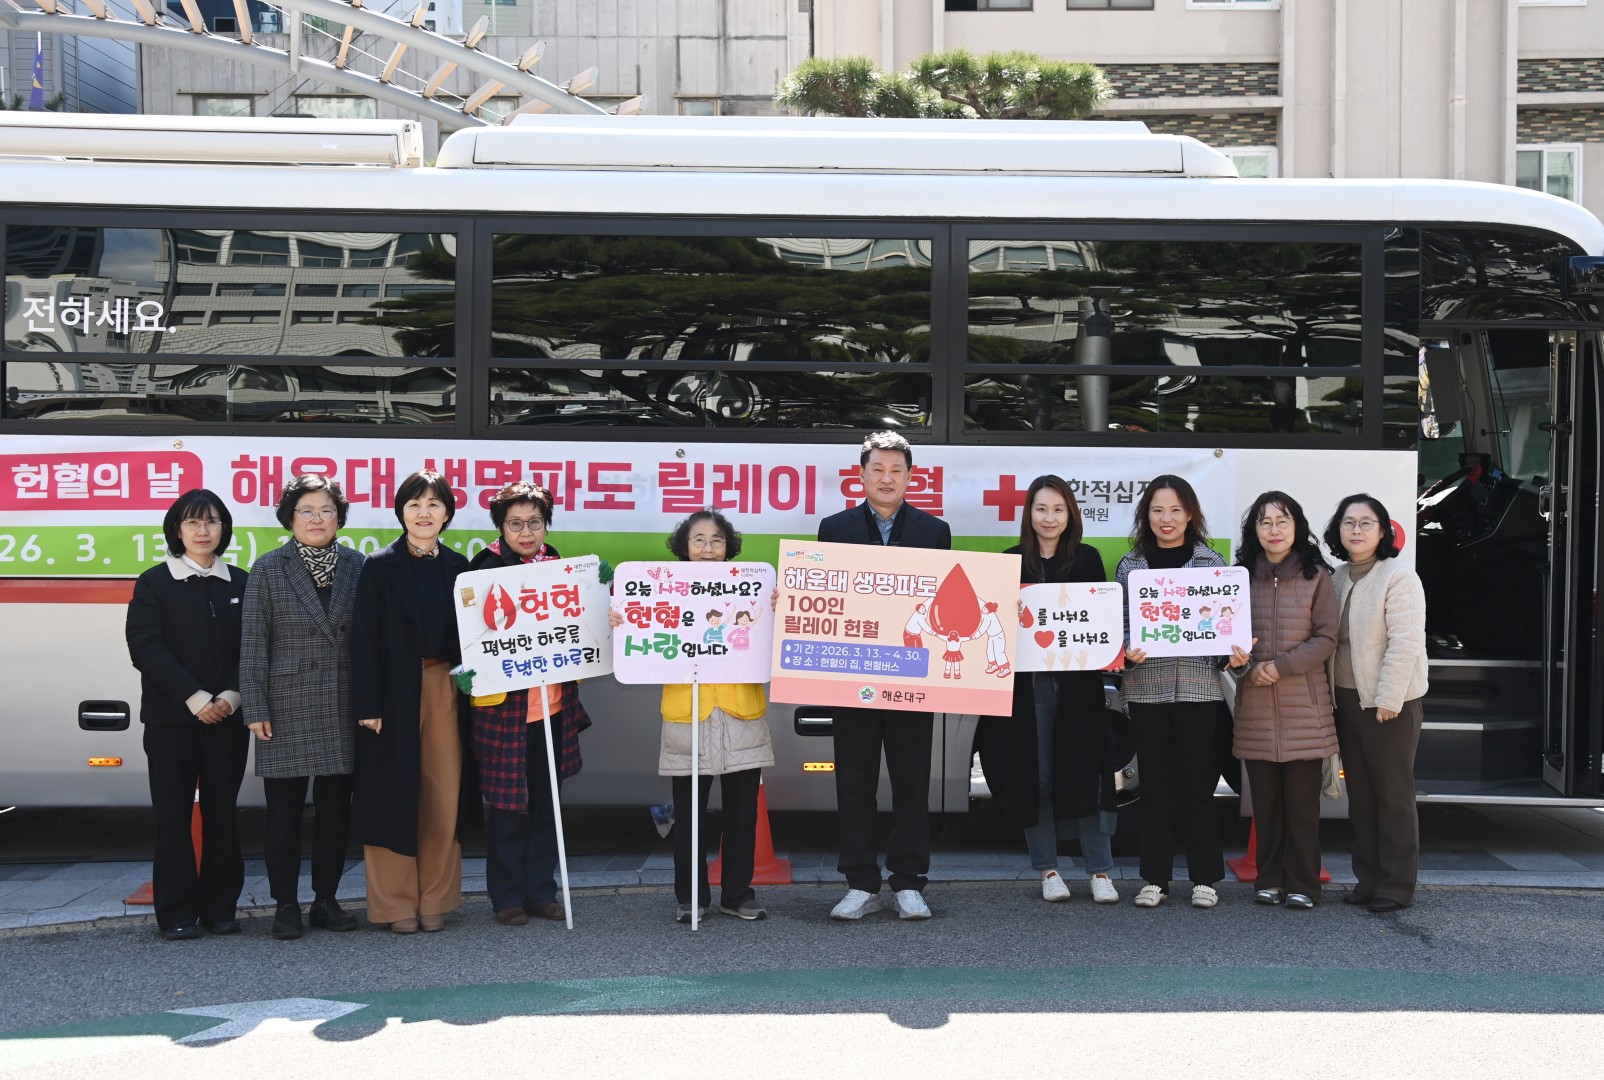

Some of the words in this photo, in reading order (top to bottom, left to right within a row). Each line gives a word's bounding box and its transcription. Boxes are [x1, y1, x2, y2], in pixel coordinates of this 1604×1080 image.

[22, 295, 177, 335] 전하세요.
[11, 462, 129, 499] 헌혈의
[147, 462, 184, 499] 날
[658, 461, 816, 515] 릴레이
[76, 533, 112, 565] 3.
[624, 580, 652, 597] 오늘
[658, 581, 762, 597] 사랑하셨나요?
[785, 567, 848, 593] 해운대
[853, 571, 937, 598] 생명파도
[1139, 587, 1159, 599] 오늘
[1163, 584, 1240, 598] 사랑하셨나요?
[518, 584, 585, 621] 헌혈,
[787, 595, 845, 615] 100인
[1139, 601, 1191, 622] 헌혈은
[624, 601, 695, 629] 헌혈은
[785, 615, 838, 636] 릴레이
[844, 618, 879, 639] 헌혈
[1037, 608, 1047, 626] 를
[1052, 610, 1089, 623] 나눠요
[481, 634, 532, 656] 평범한
[537, 624, 579, 646] 하루를
[624, 632, 729, 660] 사랑입니다
[1058, 630, 1068, 648] 을
[1072, 632, 1109, 645] 나눠요
[1140, 624, 1217, 644] 사랑입니다
[502, 656, 548, 678] 특별한
[552, 647, 600, 669] 하루로!
[820, 657, 848, 669] 헌혈의
[849, 659, 861, 671] 집,
[864, 660, 900, 672] 헌혈버스
[821, 645, 851, 657] 2026.
[853, 647, 863, 657] 3.
[866, 648, 881, 658] 13.
[893, 650, 903, 660] 4.
[905, 650, 922, 661] 30.
[881, 690, 926, 703] 해운대구
